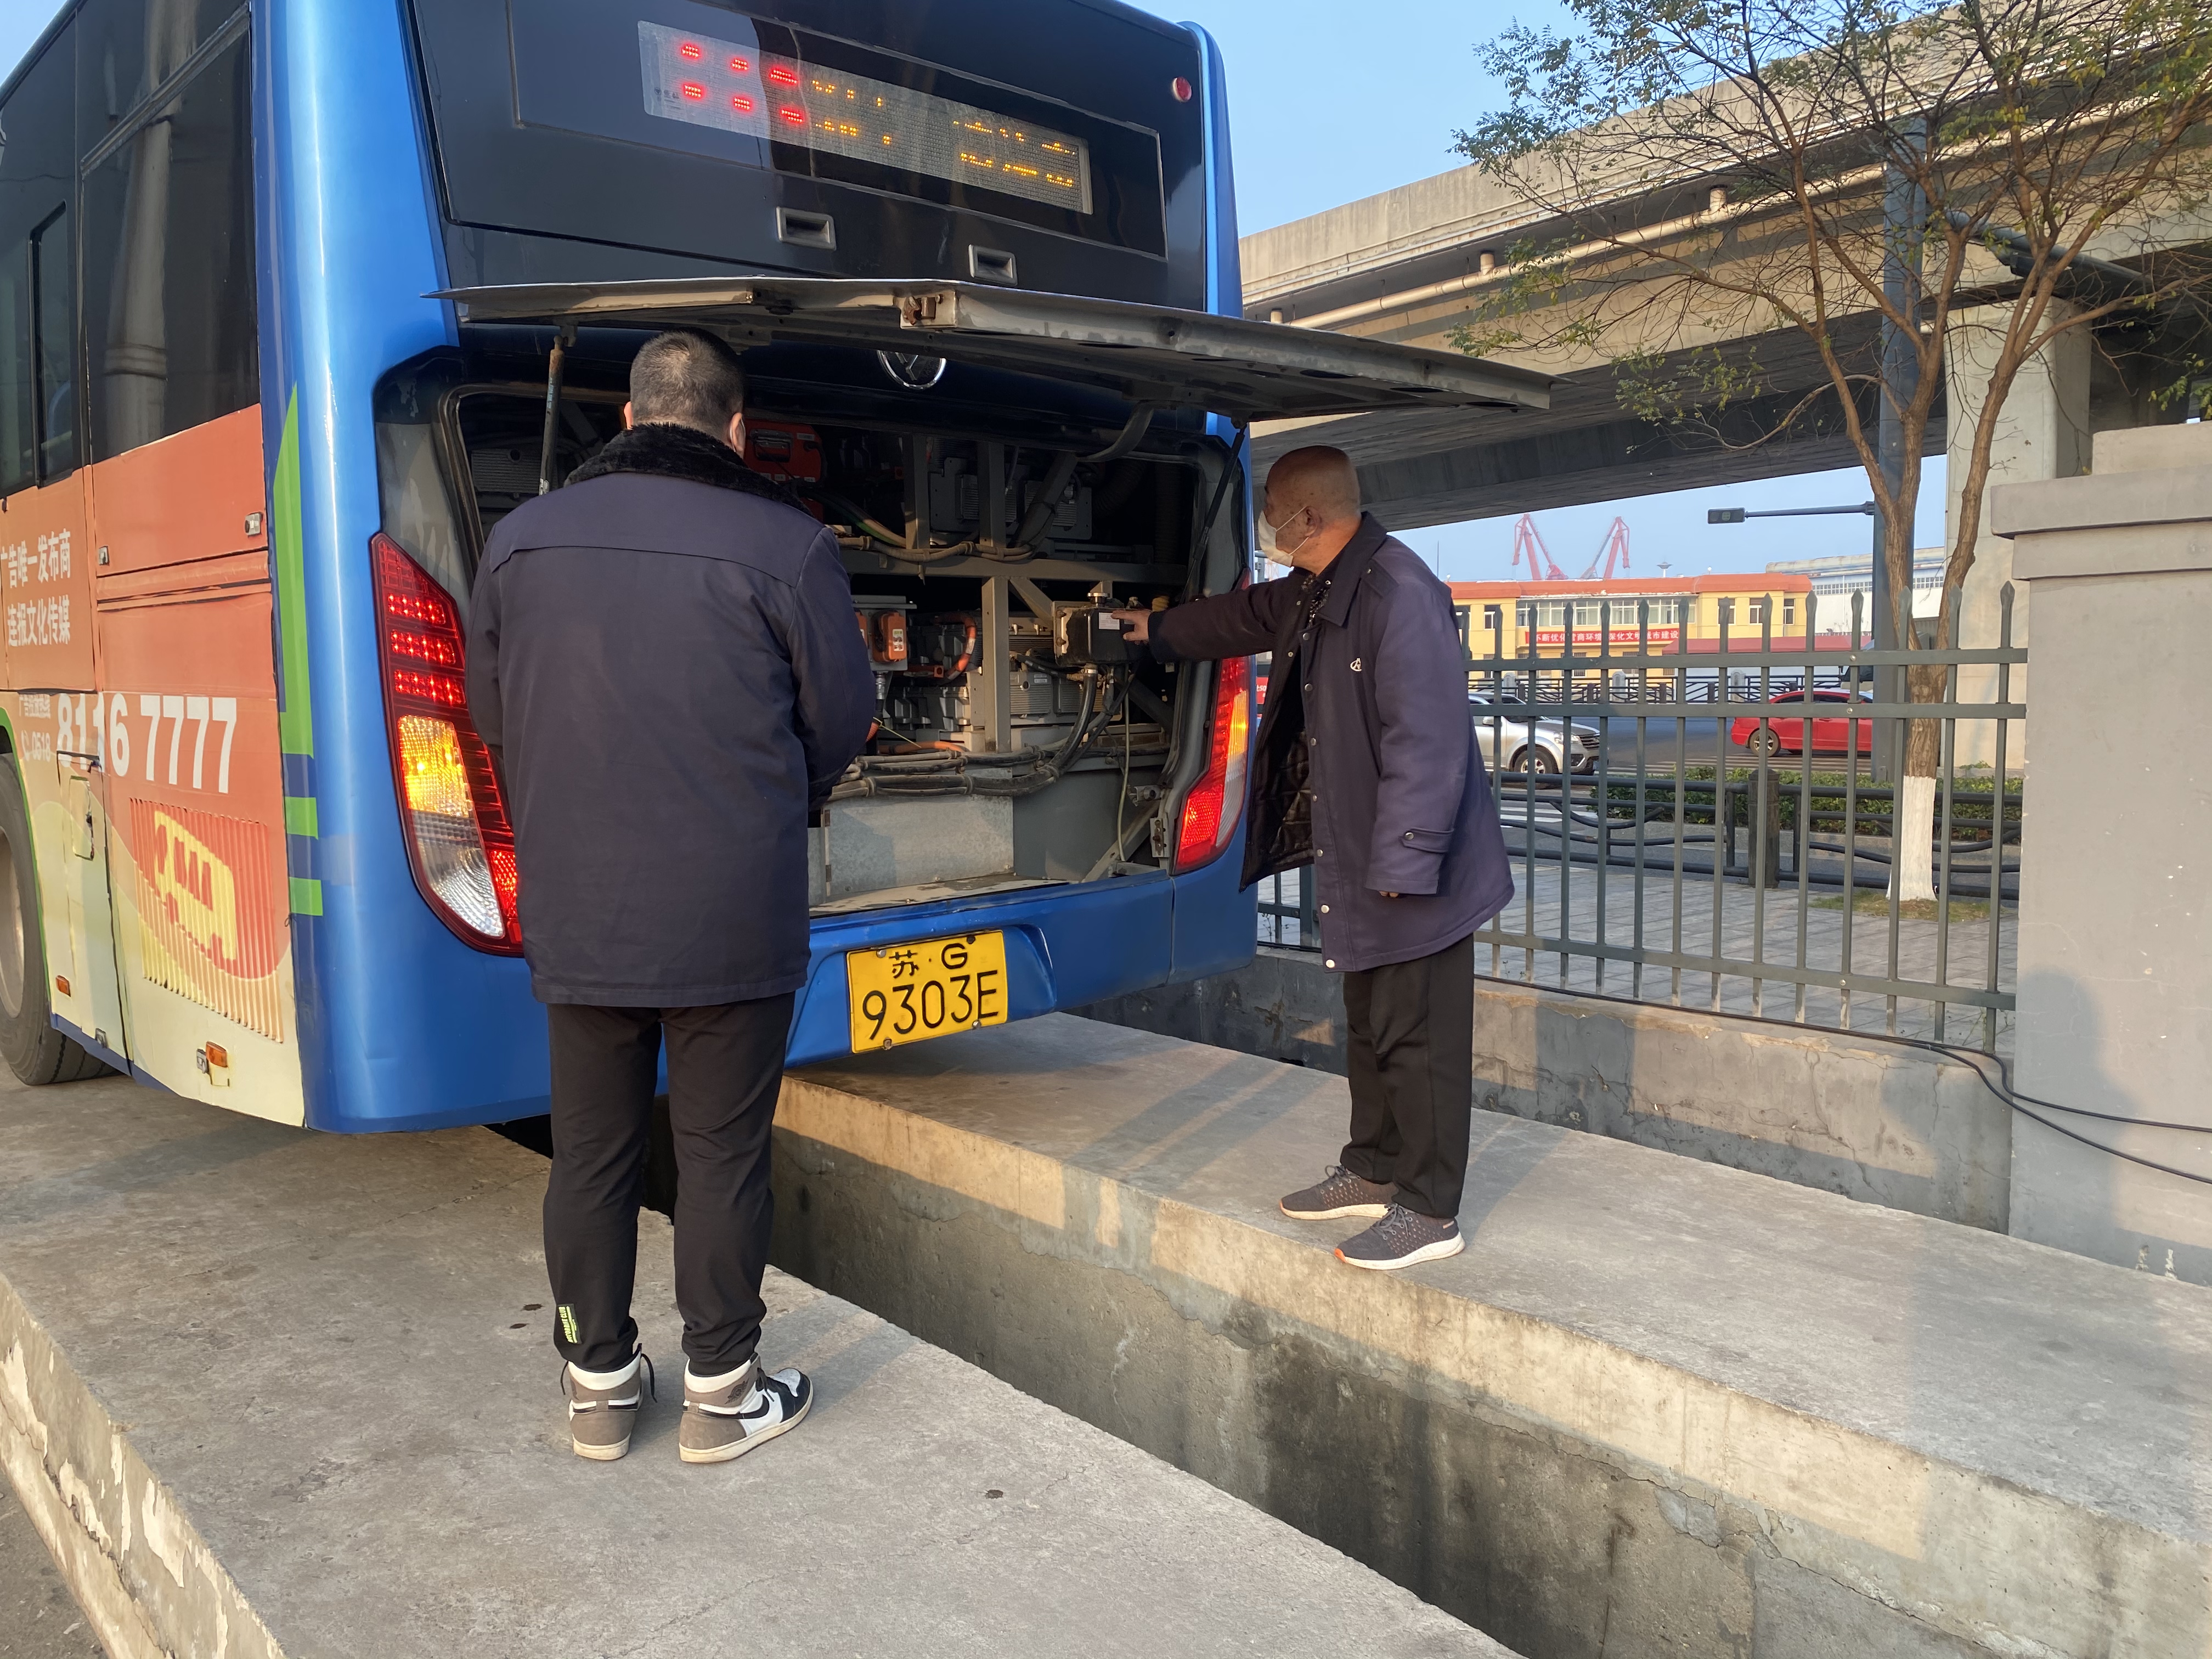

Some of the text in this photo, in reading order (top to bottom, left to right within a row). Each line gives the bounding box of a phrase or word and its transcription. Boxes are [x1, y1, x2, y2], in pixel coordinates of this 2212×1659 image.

[8, 595, 70, 646] 连报文化传媒
[57, 692, 129, 776] 8116
[140, 695, 236, 793] 7777
[862, 969, 998, 1040] 9303E
